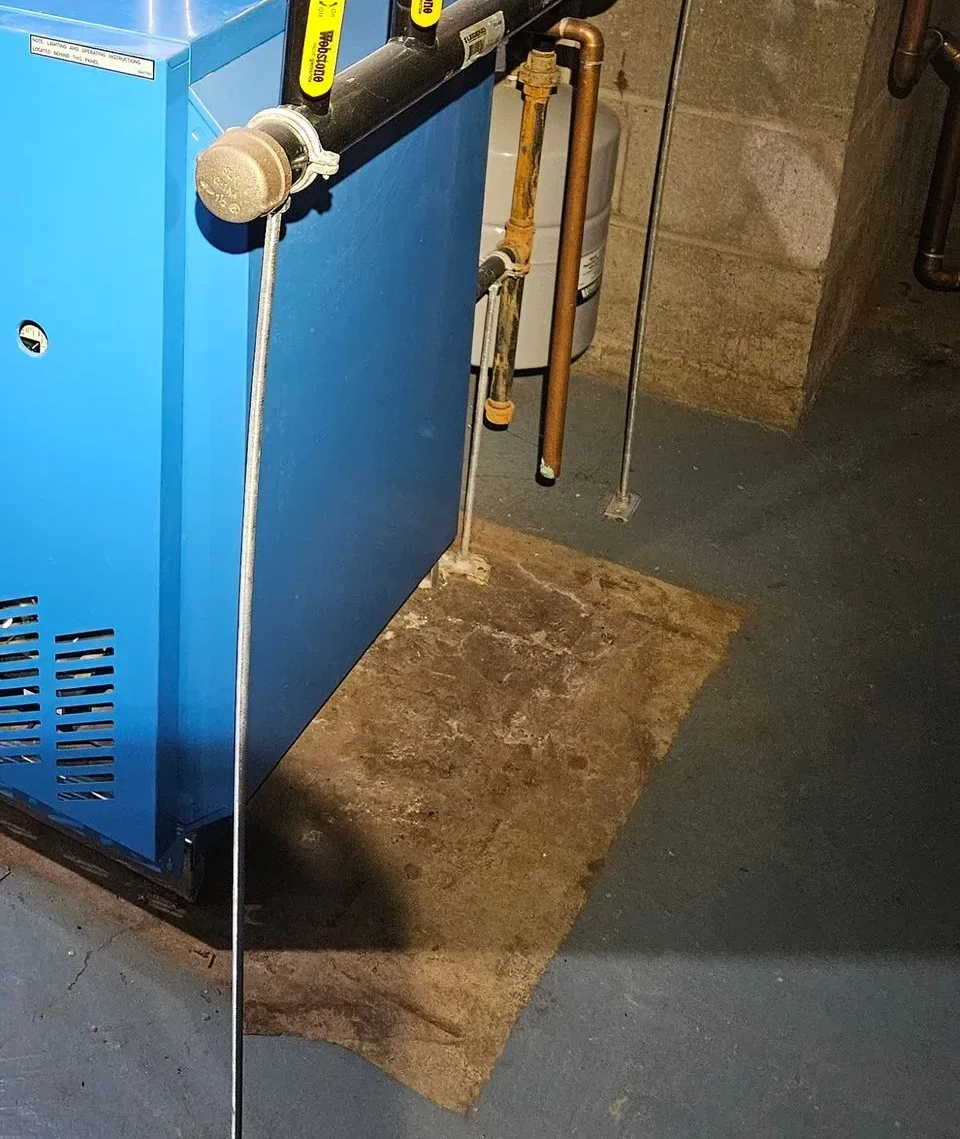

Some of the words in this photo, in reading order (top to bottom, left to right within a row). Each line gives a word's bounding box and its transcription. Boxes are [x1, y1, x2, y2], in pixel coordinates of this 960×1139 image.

[32, 46, 52, 55] LOCATED
[53, 50, 71, 59] BEHIND
[72, 54, 82, 62] THIS
[46, 41, 68, 50] LIGHTING
[81, 47, 106, 57] OPERATING
[108, 53, 142, 66] INSTRUCTIONS
[313, 30, 335, 83] Webstone
